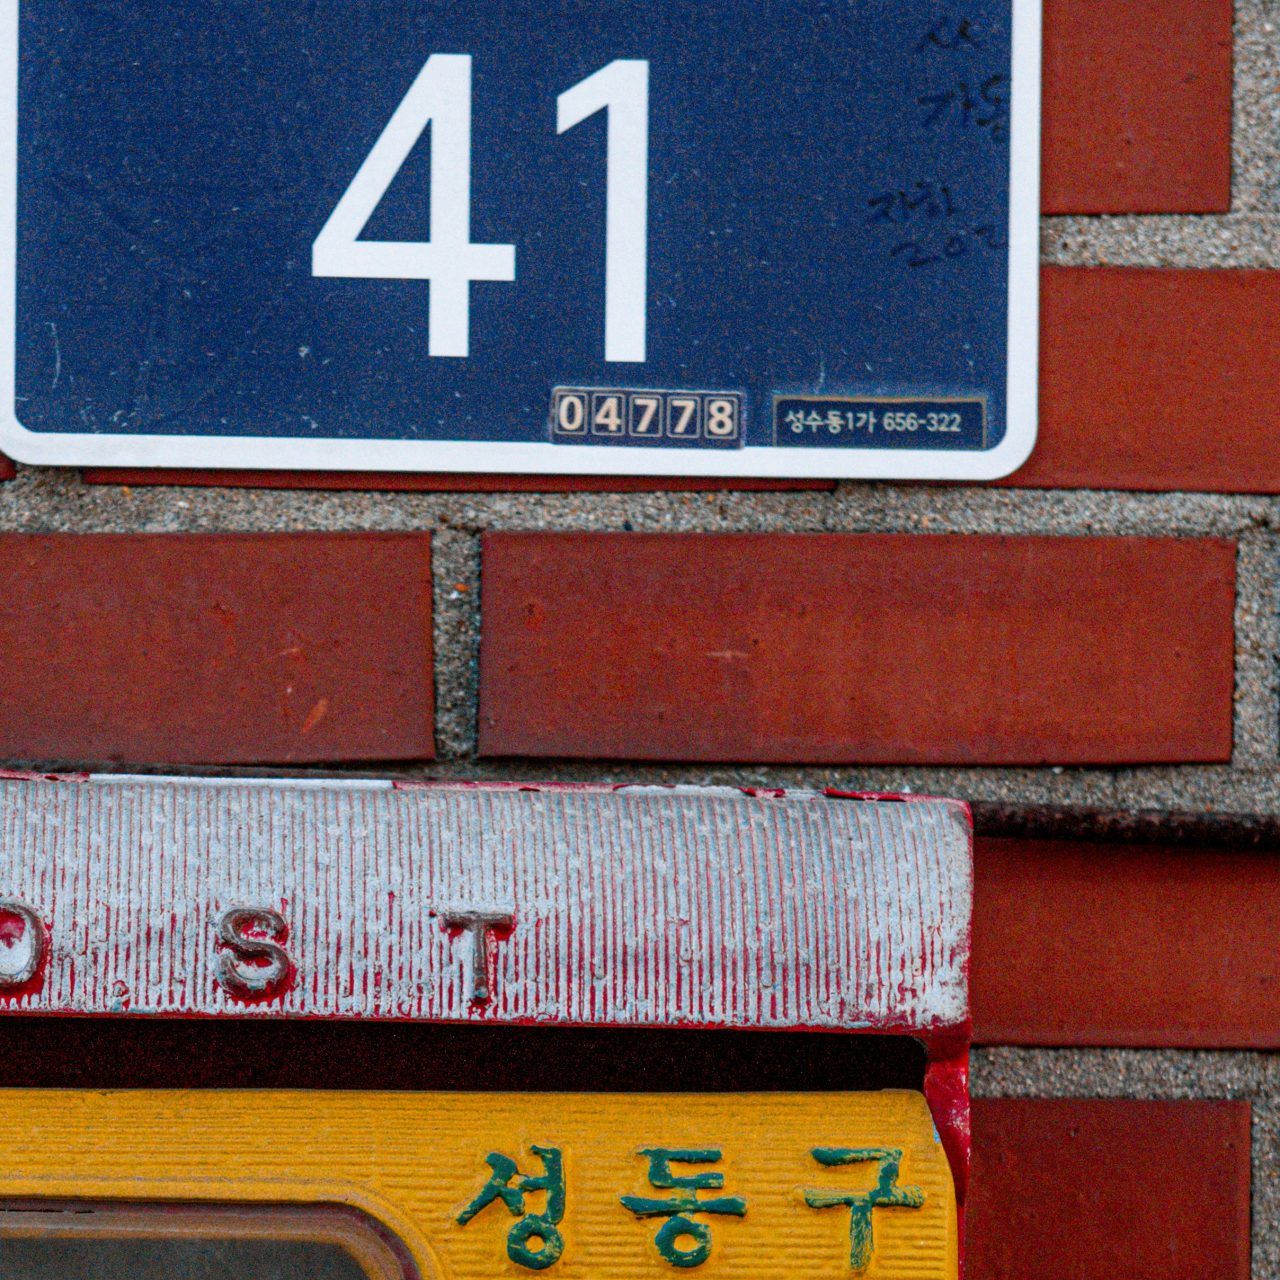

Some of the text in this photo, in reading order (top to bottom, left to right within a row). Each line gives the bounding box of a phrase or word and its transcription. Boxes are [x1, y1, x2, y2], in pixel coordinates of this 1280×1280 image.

[312, 53, 649, 363] 41
[557, 394, 736, 436] 04778
[784, 408, 962, 434] 성수동1가 656-322
[455, 1144, 926, 1273] 성동구
